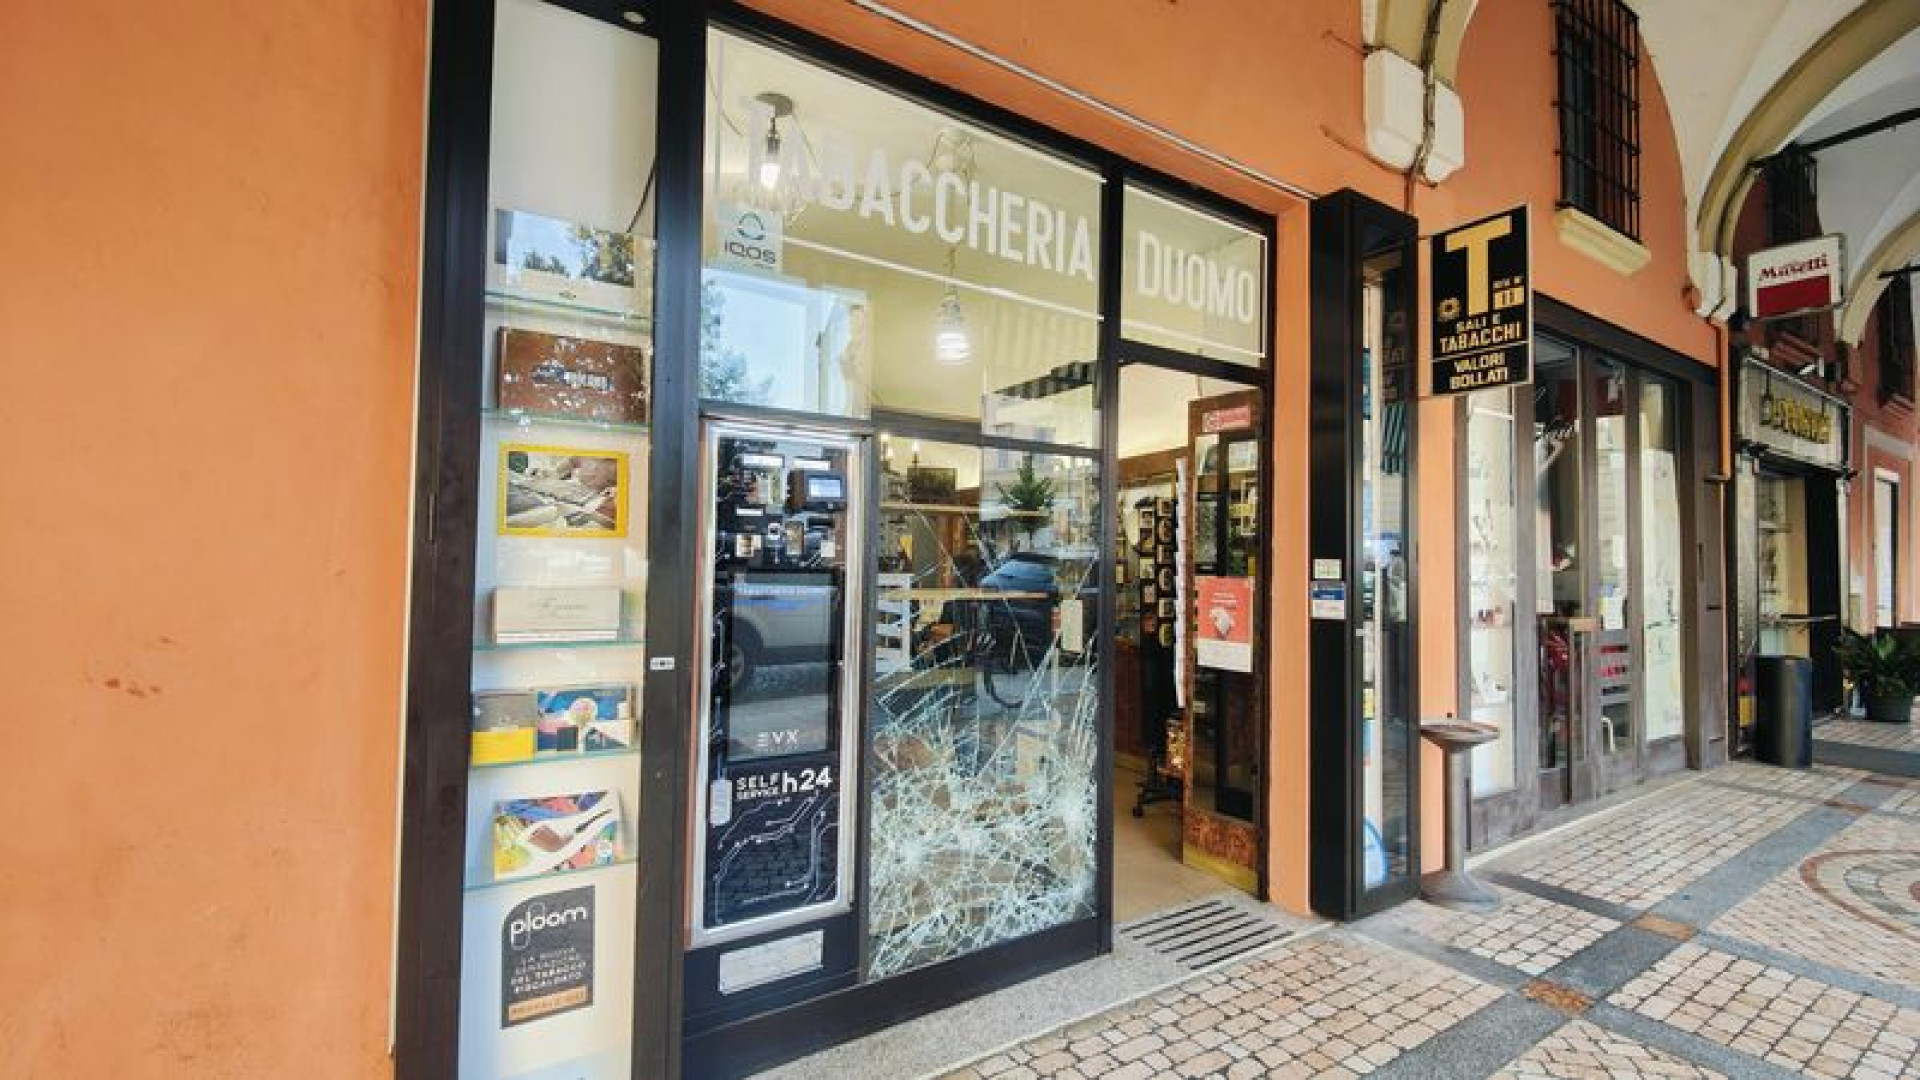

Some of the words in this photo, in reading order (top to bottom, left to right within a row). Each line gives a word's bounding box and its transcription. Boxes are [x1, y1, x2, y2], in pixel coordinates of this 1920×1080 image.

[1136, 230, 1256, 324] DUOMO
[1446, 215, 1512, 316] T
[1759, 252, 1829, 281] Musetti
[1439, 320, 1522, 354] TABACCHI
[1454, 352, 1506, 373] VALORI
[1450, 366, 1508, 390] BOLLATI
[736, 772, 780, 791] SELF
[781, 766, 833, 793] h24
[510, 903, 588, 950] ploom
